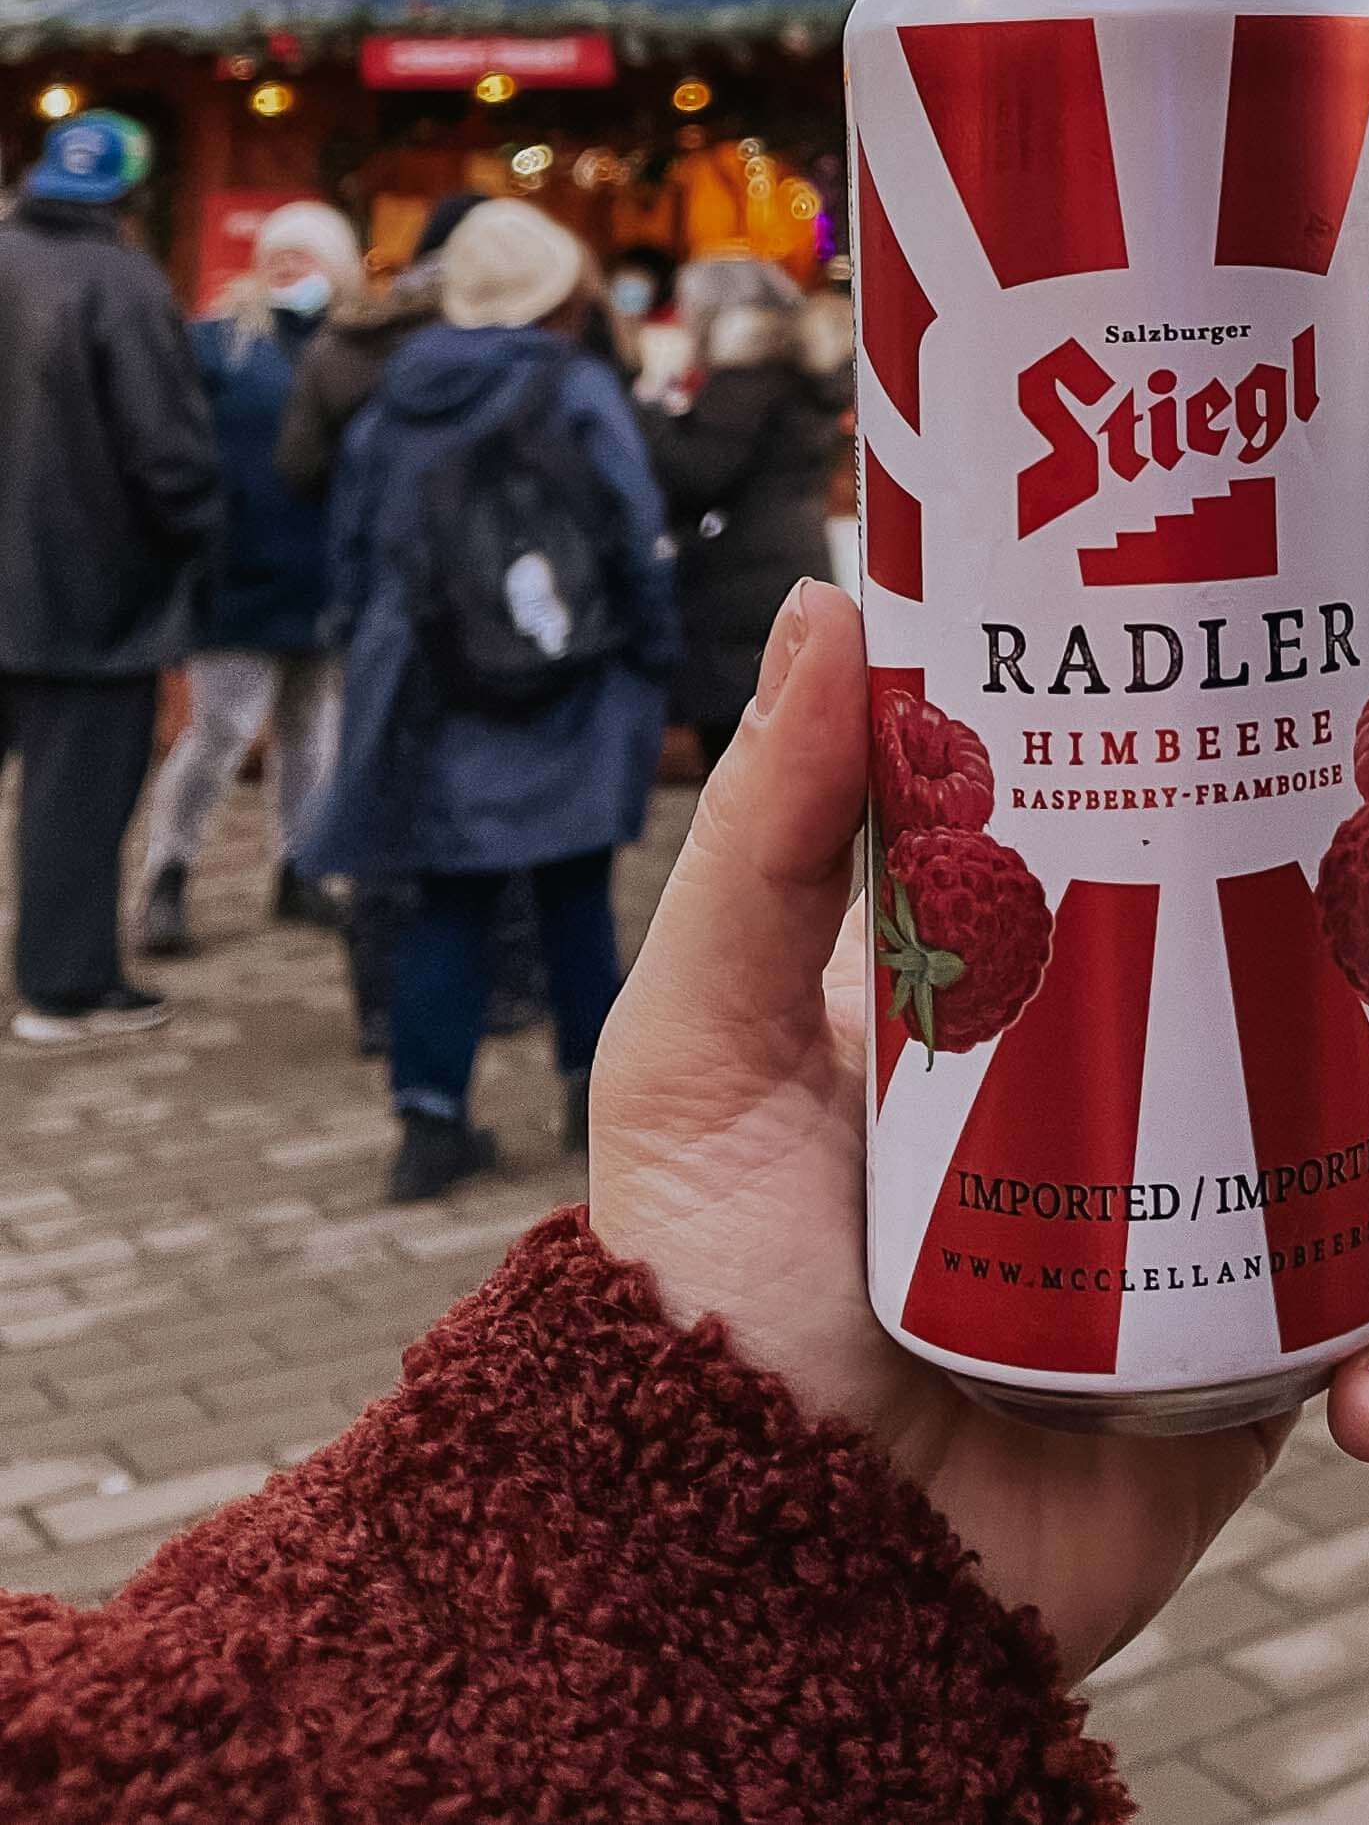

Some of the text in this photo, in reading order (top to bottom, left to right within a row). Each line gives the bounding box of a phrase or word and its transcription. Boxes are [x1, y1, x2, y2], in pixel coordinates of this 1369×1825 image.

[1104, 323, 1252, 345] Salzburger
[1016, 323, 1321, 541] Stiegl
[981, 602, 1361, 695] RADLER
[1022, 709, 1333, 766] HIMBEERE
[1011, 763, 1343, 811] RASPBERRY-FRAMBOISE
[957, 1170, 1181, 1222] IMPORTED
